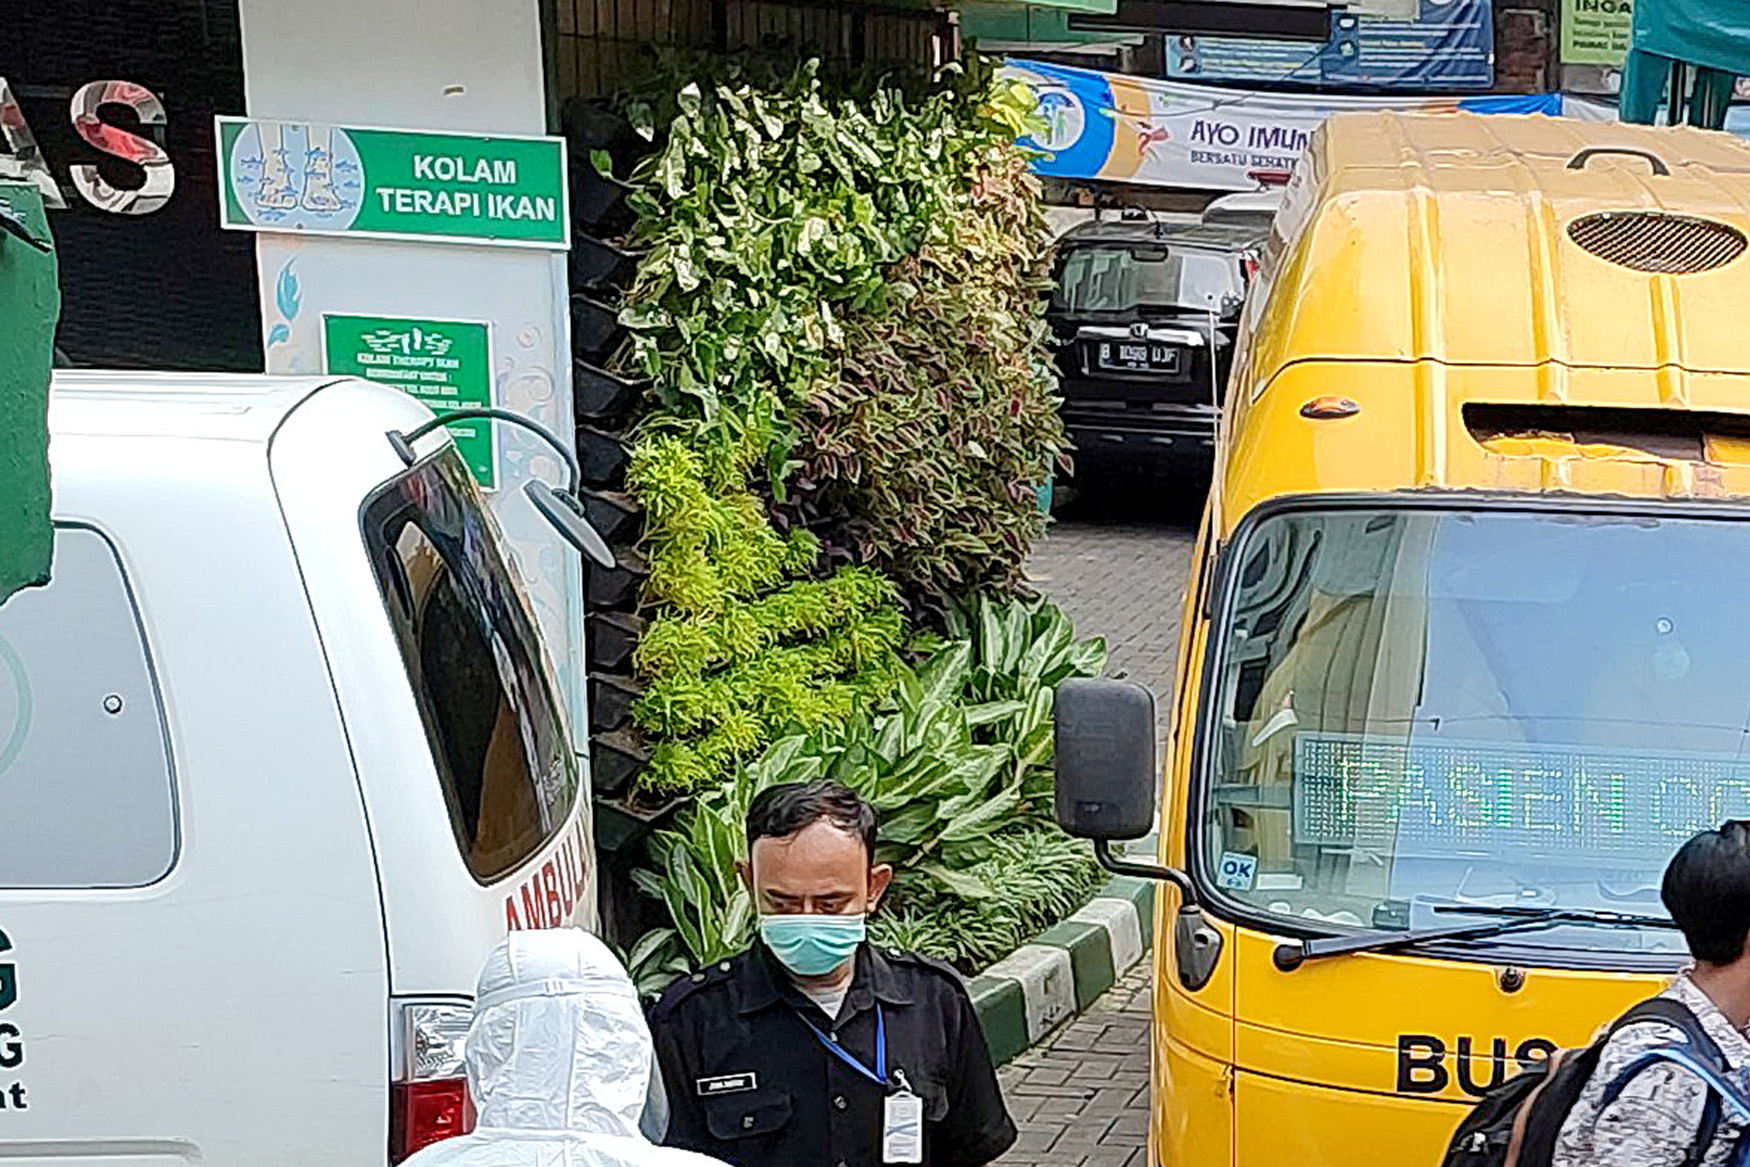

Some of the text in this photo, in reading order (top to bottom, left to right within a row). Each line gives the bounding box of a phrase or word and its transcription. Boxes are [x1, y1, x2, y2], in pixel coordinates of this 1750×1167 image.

[1190, 119, 1316, 151] AYO IMUN
[412, 154, 517, 185] KOLAM
[375, 187, 556, 222] TERAPI IKAN
[1223, 860, 1253, 879] OK
